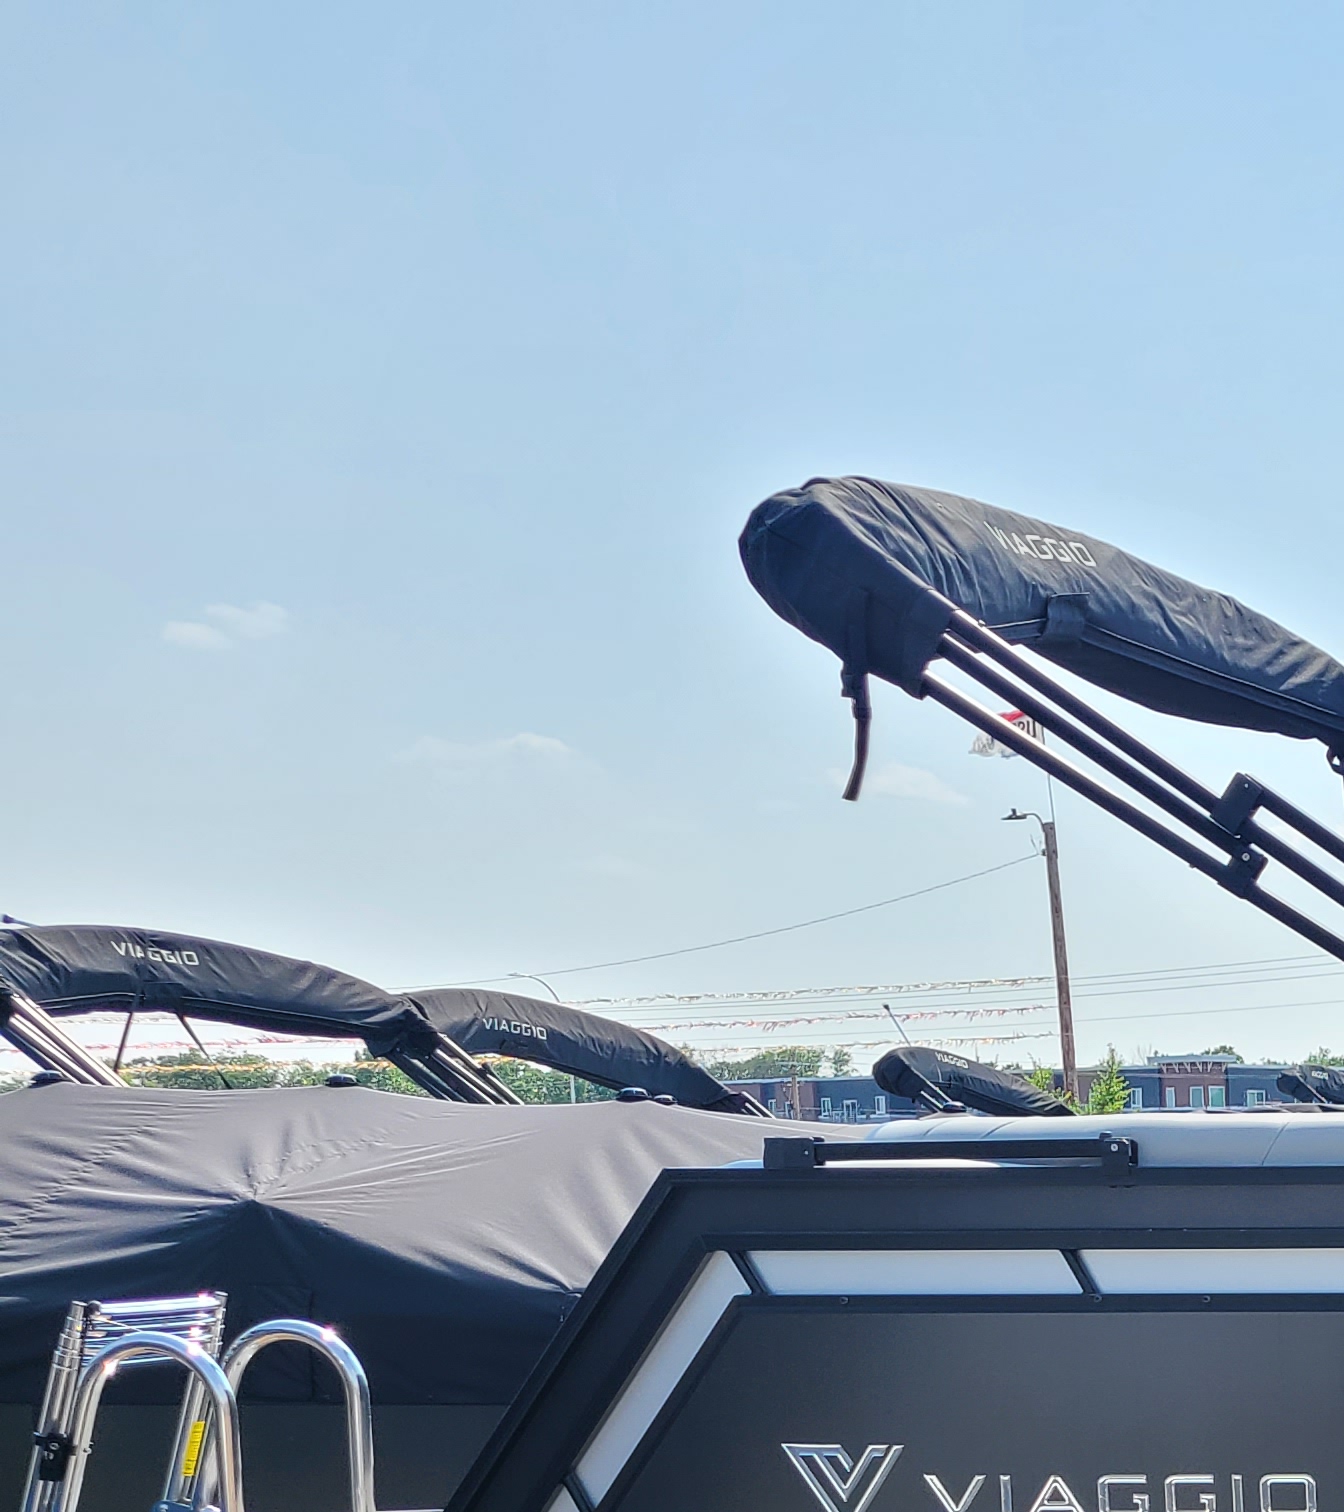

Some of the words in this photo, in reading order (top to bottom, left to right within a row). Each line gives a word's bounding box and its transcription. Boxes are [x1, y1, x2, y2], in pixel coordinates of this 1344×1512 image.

[983, 520, 1097, 567] VIAGGIO
[110, 940, 200, 966] VIAGGIO
[482, 1018, 547, 1040] VIAGGIO
